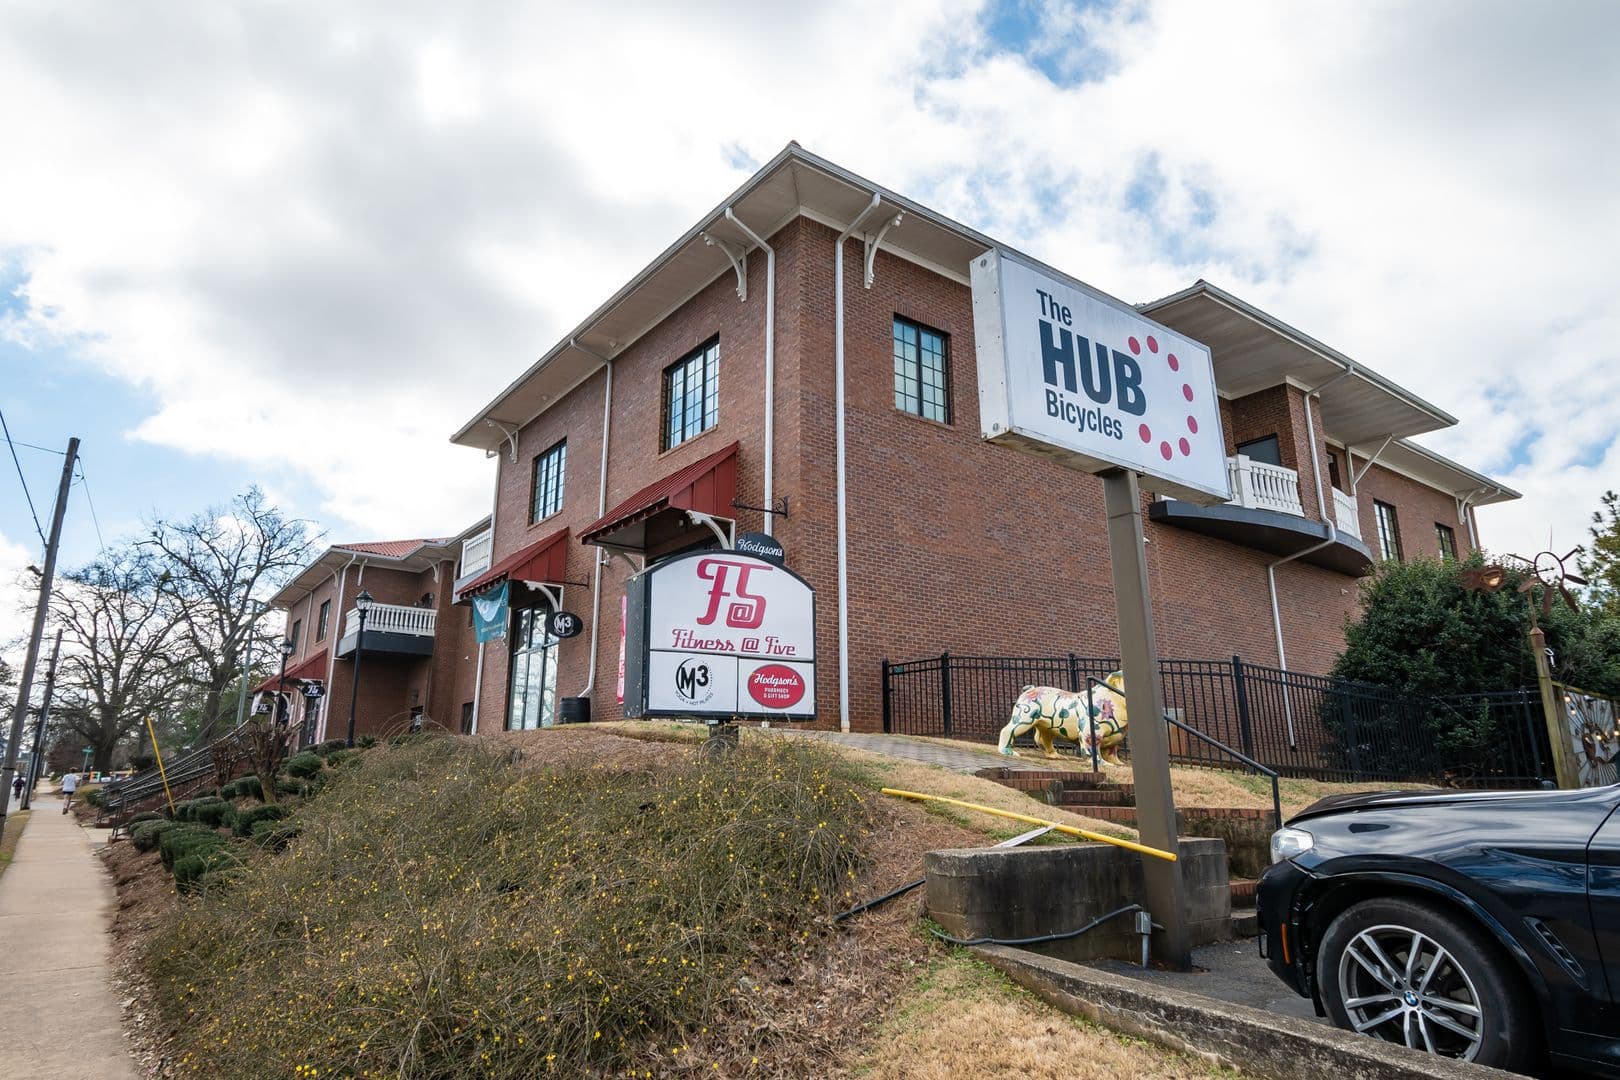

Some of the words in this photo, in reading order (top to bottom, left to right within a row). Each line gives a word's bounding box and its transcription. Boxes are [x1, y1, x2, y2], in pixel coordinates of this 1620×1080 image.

[1036, 288, 1073, 327] The
[1038, 318, 1147, 417] HUB
[1045, 388, 1123, 441] Bicycles
[671, 628, 736, 652] Fitness
[740, 637, 760, 654] @
[765, 635, 797, 656] Five
[679, 664, 709, 700] M3
[753, 673, 799, 687] Hodgson's
